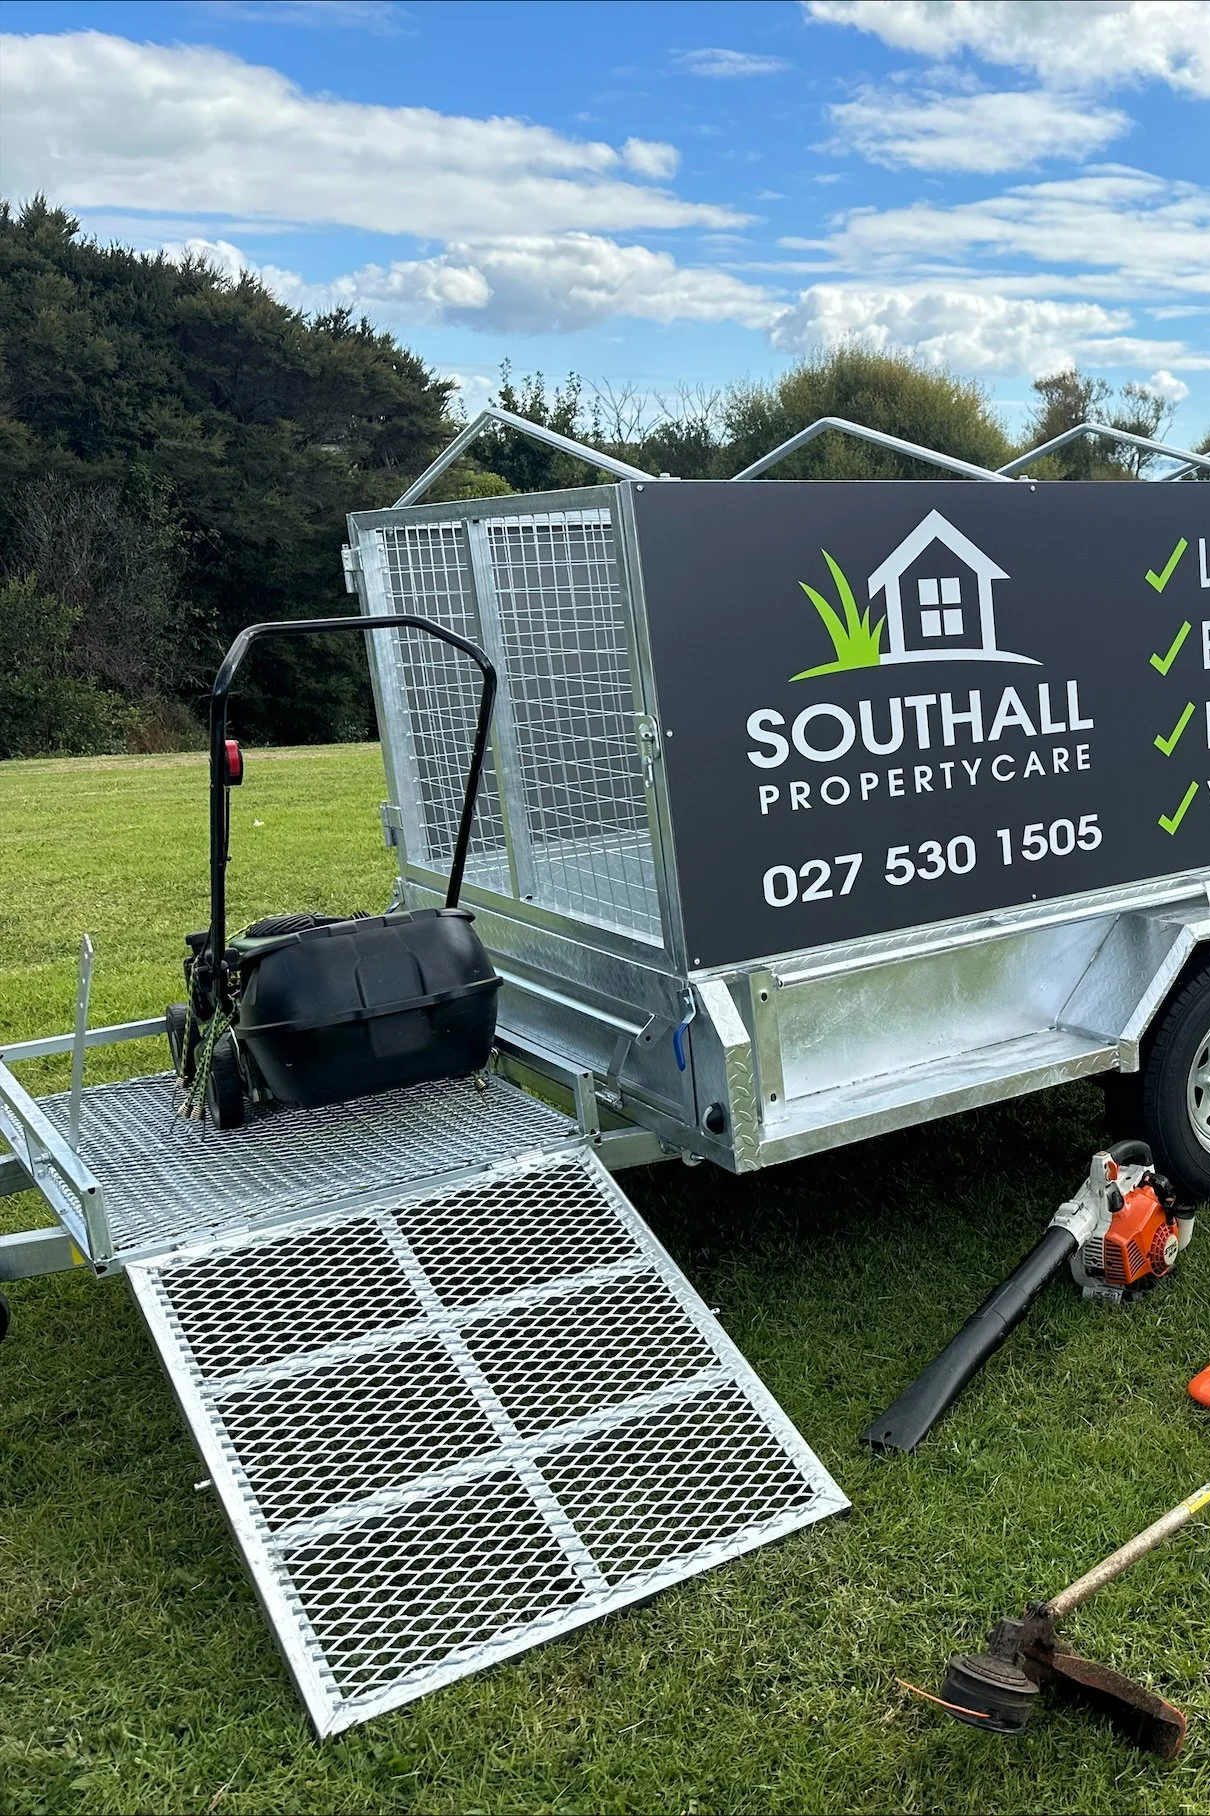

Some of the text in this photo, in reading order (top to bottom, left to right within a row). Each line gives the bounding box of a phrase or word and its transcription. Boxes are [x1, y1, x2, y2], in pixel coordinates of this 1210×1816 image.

[746, 679, 1094, 769] SOUTHALL
[758, 743, 1091, 815] PROPERTYCARE
[762, 813, 1103, 908] 027 530 1505
